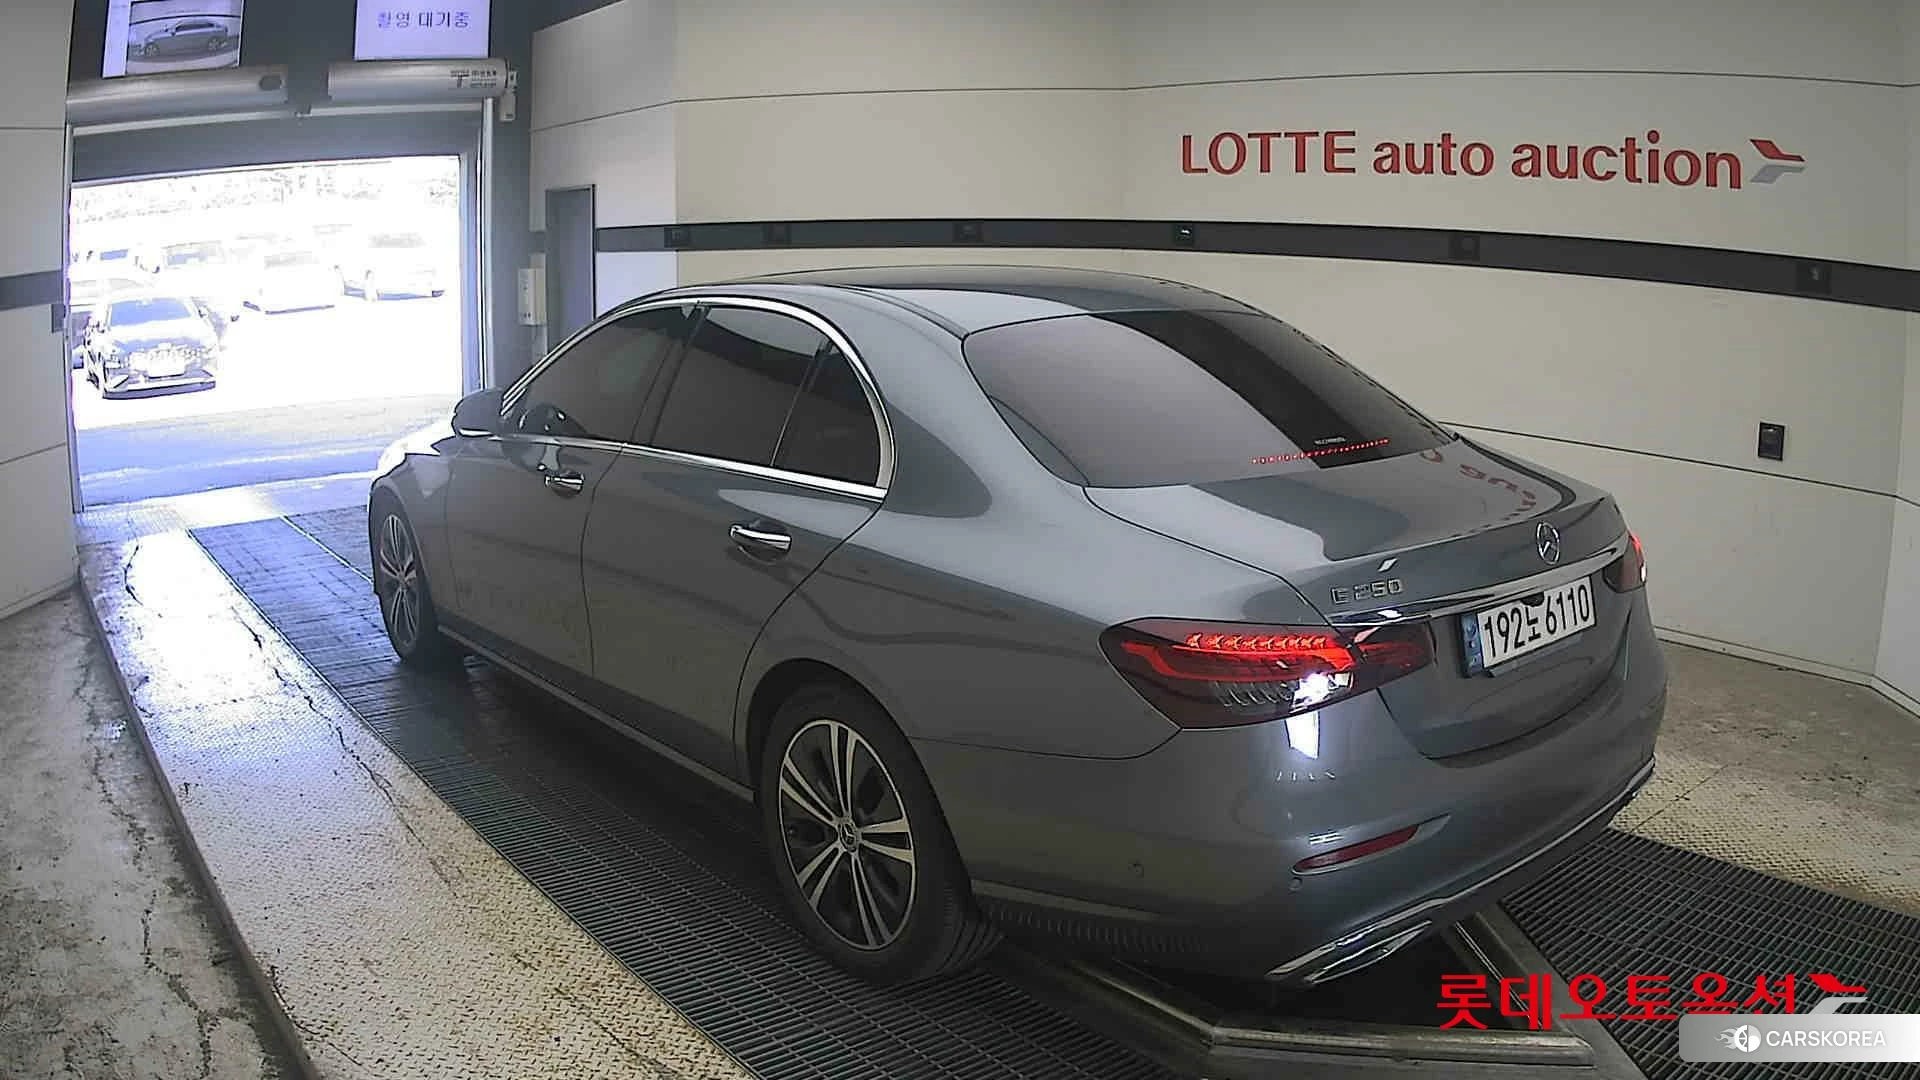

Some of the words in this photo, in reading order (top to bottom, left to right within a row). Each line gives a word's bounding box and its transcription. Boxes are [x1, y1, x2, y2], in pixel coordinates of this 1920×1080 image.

[418, 10, 468, 28] 대기중
[1182, 130, 1356, 173] LOTTE
[1373, 133, 1494, 176] auto
[1512, 130, 1741, 189] auction
[1330, 586, 1350, 605] E
[1353, 578, 1402, 600] 250
[1545, 584, 1590, 635] 6110
